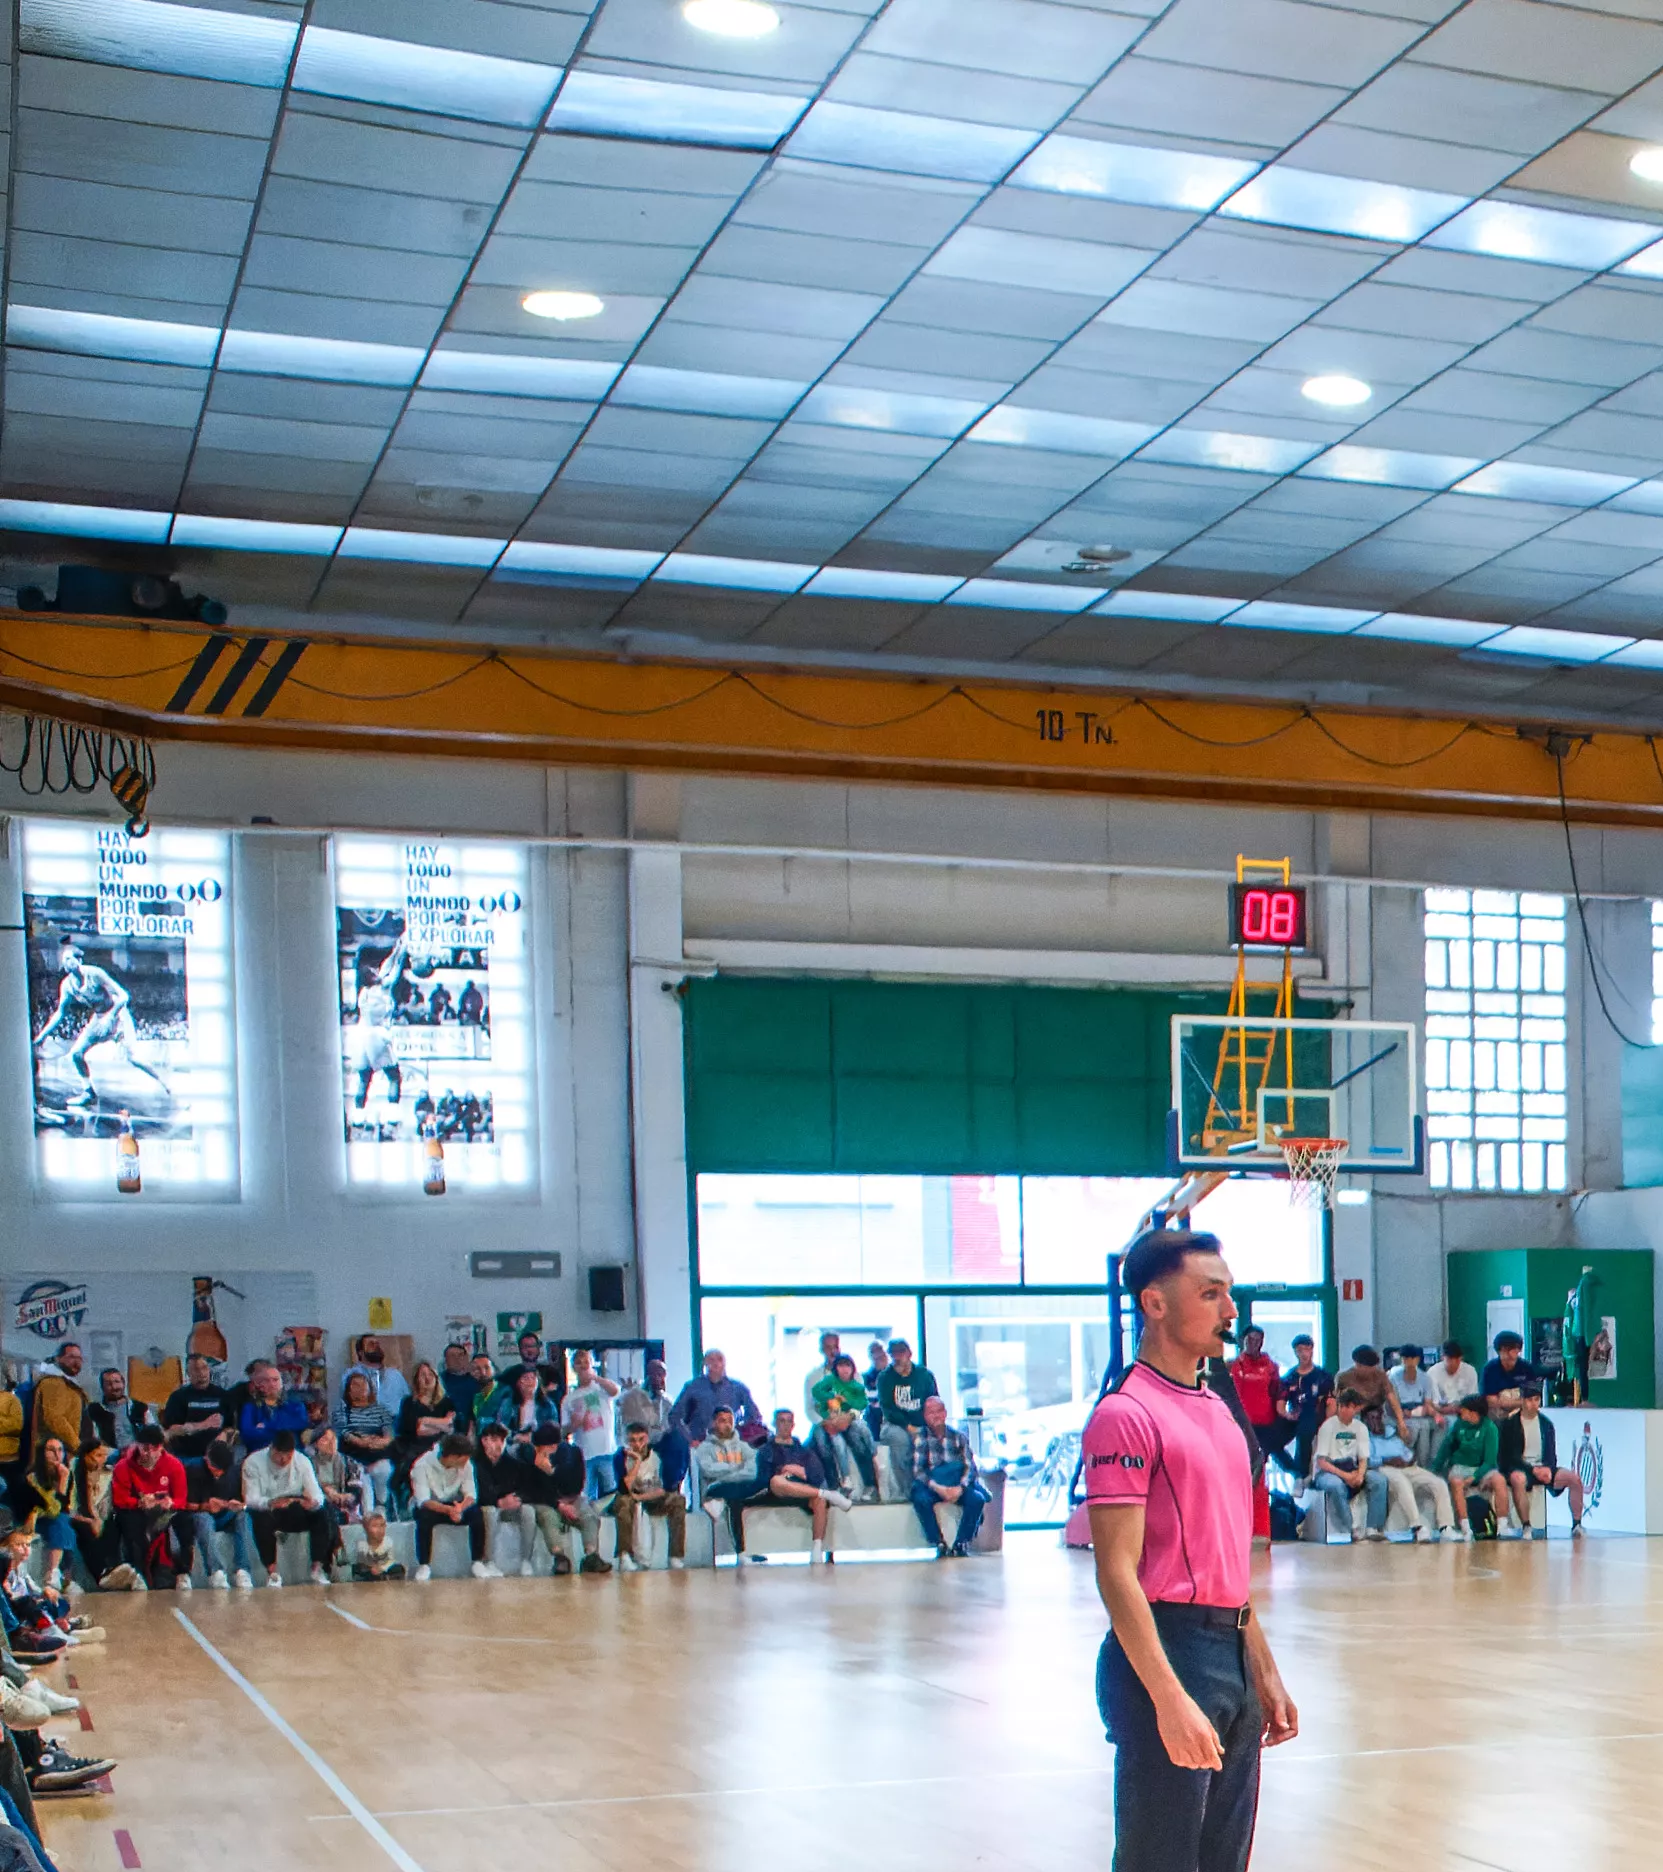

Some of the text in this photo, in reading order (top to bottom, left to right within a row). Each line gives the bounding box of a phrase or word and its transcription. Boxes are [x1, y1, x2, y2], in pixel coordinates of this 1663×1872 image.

[1036, 708, 1064, 742] 10
[98, 830, 131, 846] HAY
[98, 847, 147, 865] TODO
[405, 844, 440, 861] HAY
[99, 865, 124, 881] UN
[406, 862, 451, 879] TODO
[99, 882, 168, 900] MUNDO
[406, 879, 431, 893] UN
[100, 899, 136, 915] POR
[406, 895, 471, 911] MUNDO
[407, 910, 442, 926] POR
[1241, 890, 1296, 941] 08
[100, 916, 194, 935] EXPLORAR
[407, 927, 495, 945] EXPLORAR
